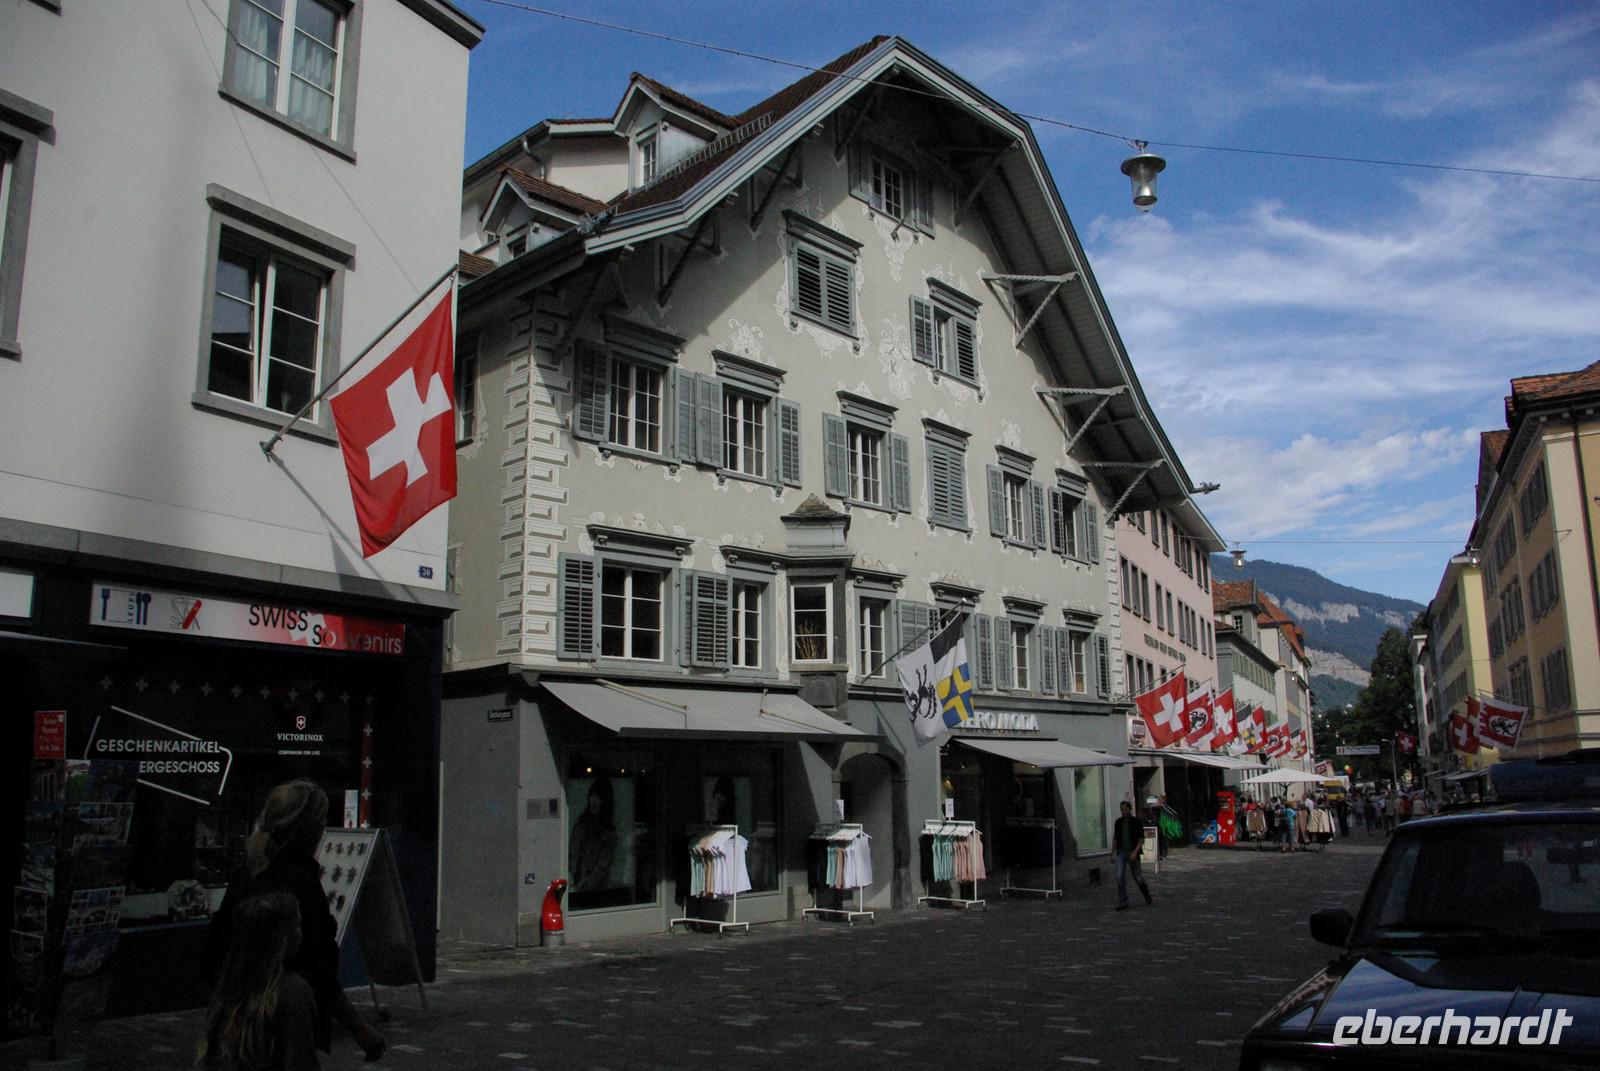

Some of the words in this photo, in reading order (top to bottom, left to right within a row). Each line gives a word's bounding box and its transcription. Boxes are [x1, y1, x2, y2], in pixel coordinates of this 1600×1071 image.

[249, 604, 308, 631] SWISS
[960, 711, 997, 730] ERO
[96, 738, 221, 753] GESCHENKARTIKEL
[277, 732, 324, 742] VICTORINOX
